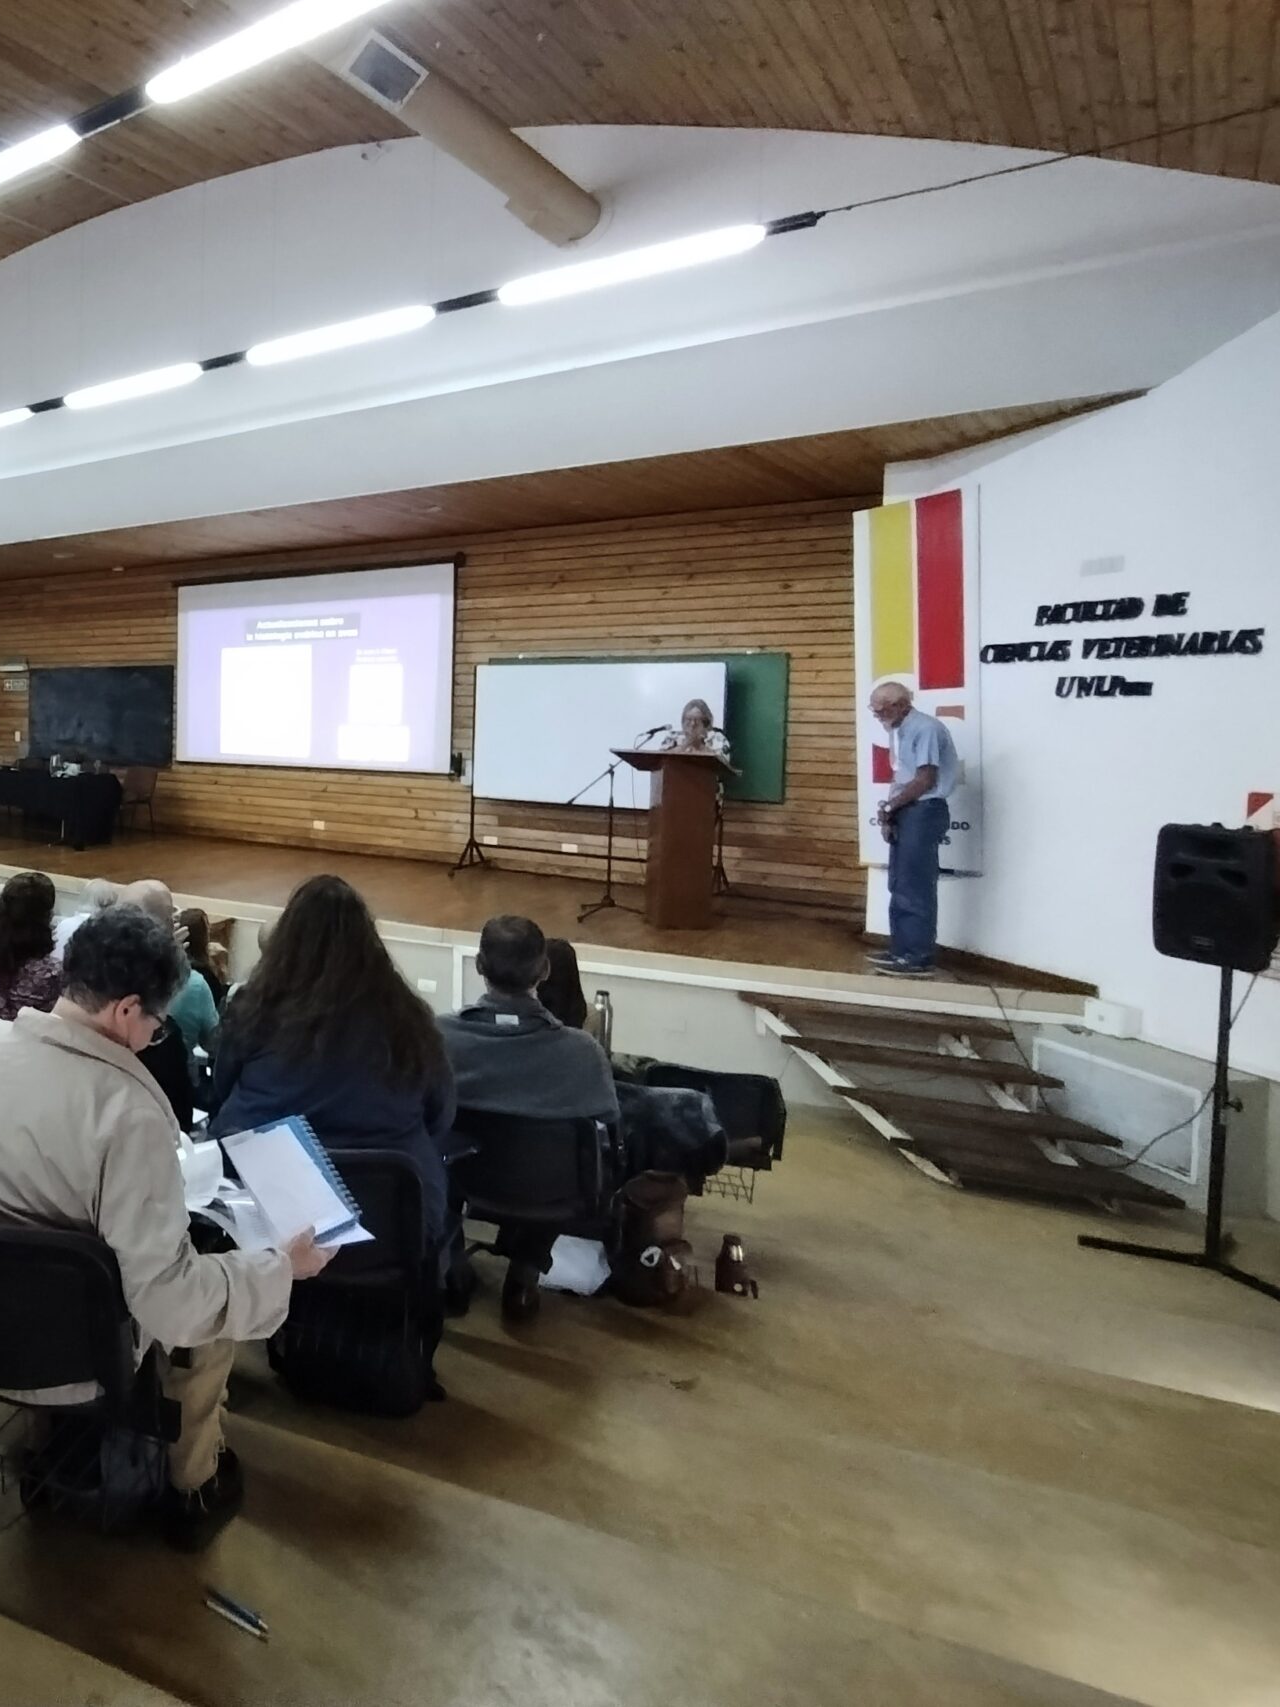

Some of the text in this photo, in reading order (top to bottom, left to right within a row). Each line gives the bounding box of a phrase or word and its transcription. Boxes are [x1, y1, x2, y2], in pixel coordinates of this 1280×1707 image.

[1034, 591, 1191, 627] FACULTAD DE
[979, 627, 1266, 664] CIENCIAS VETERINARIAS
